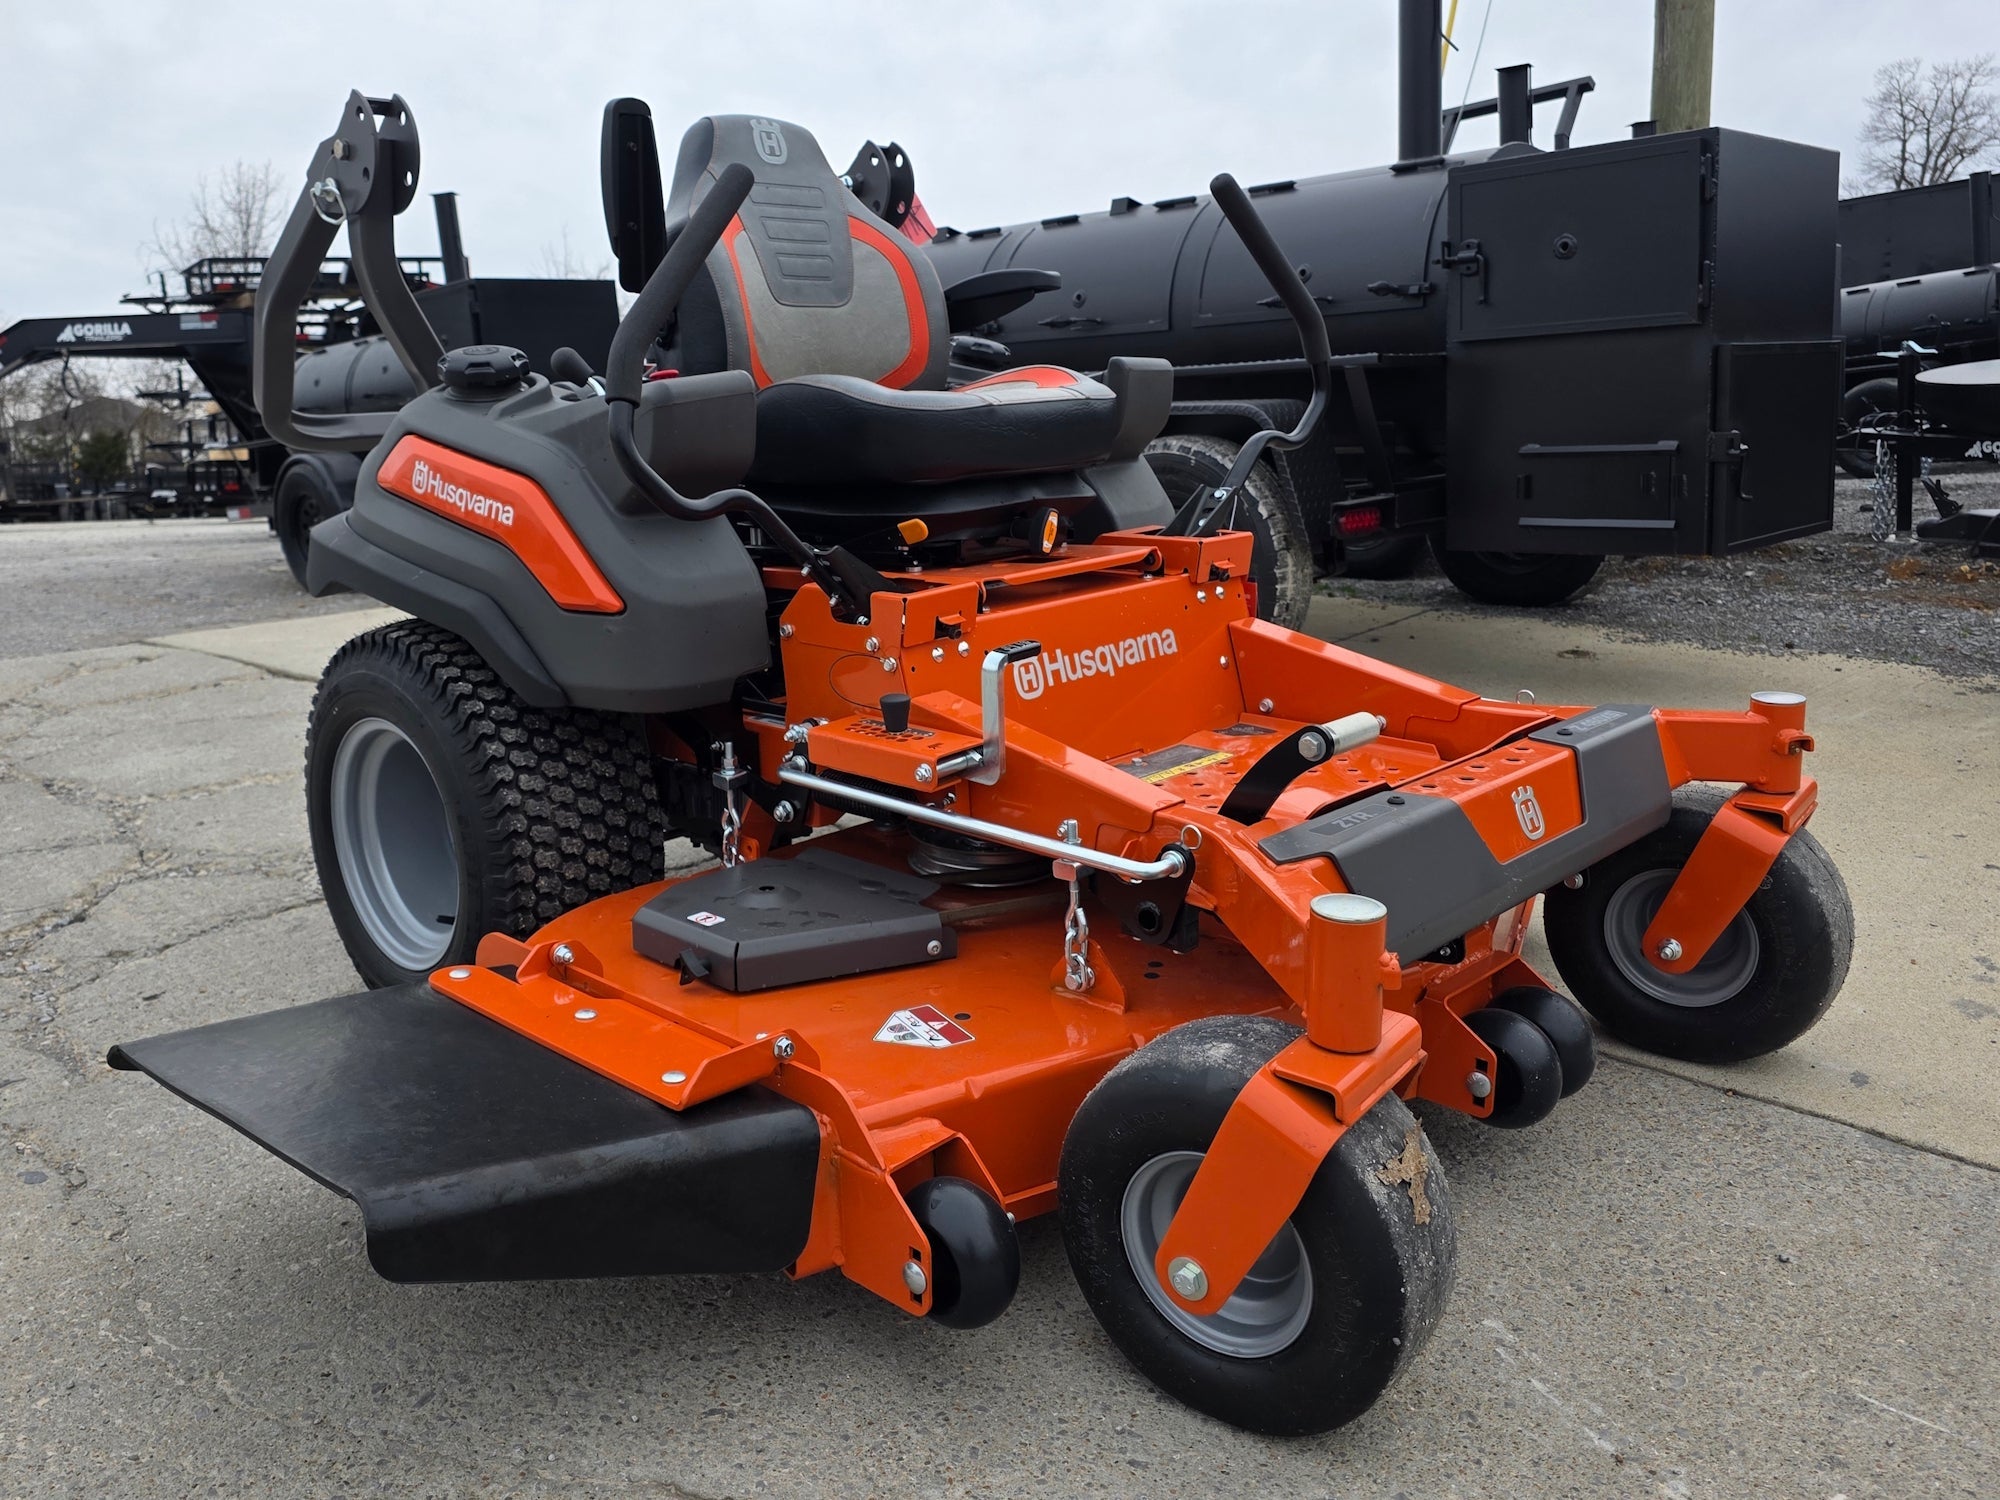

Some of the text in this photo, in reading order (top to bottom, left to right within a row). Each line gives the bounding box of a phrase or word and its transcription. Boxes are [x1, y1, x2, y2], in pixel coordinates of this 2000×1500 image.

[73, 322, 133, 337] GORILLA
[427, 470, 515, 526] Husqvarna
[1042, 628, 1178, 687] Husqvarna
